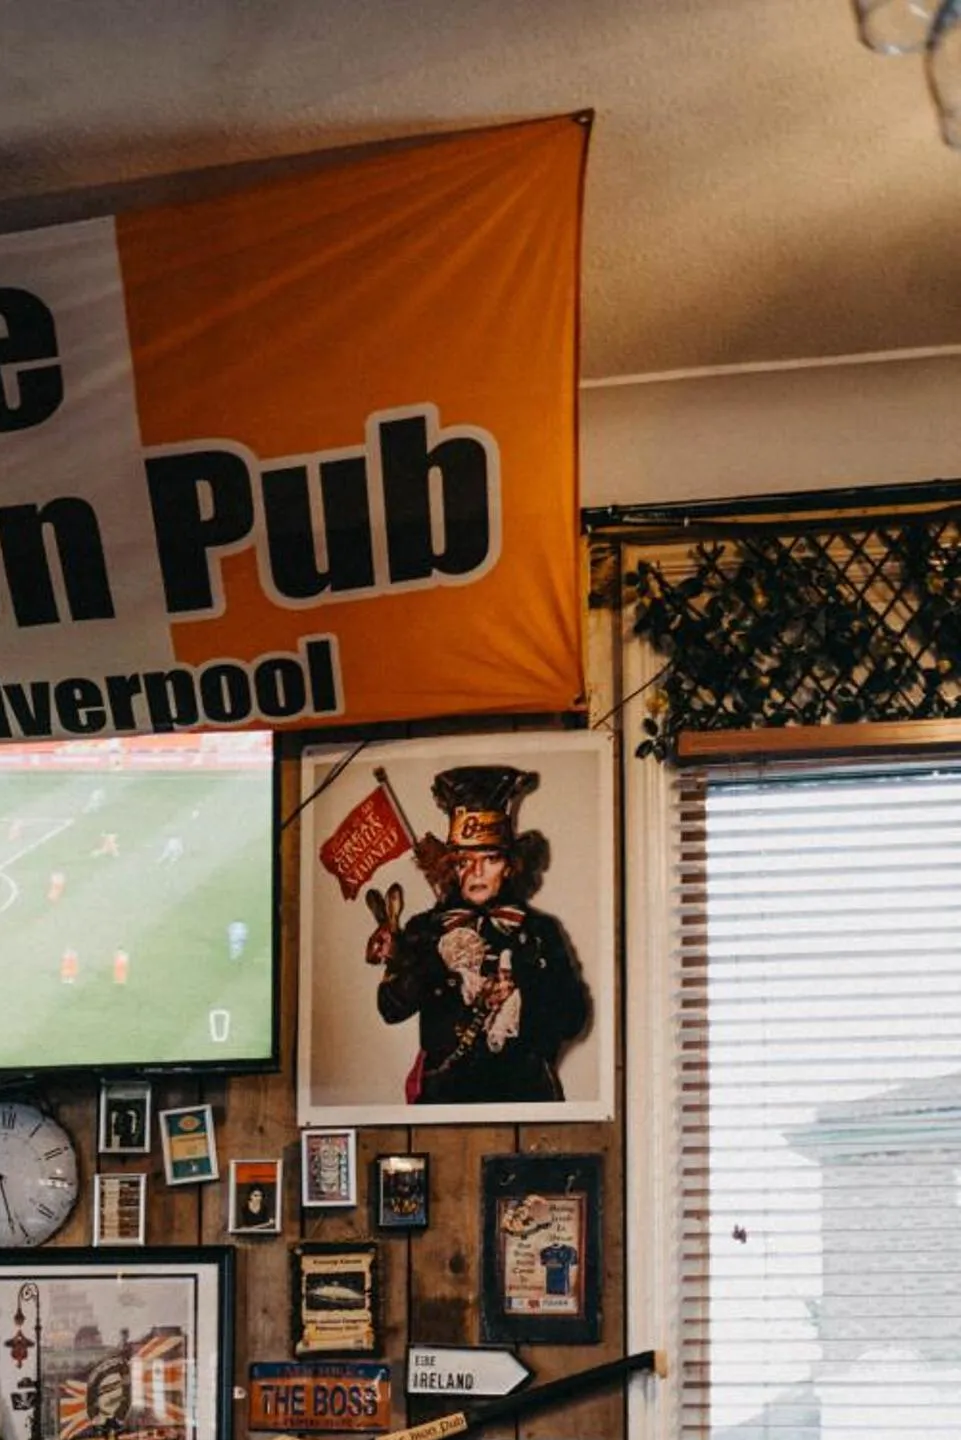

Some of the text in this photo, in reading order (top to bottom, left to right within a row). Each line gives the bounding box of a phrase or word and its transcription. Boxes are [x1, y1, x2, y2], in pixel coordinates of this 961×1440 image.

[142, 413, 492, 615] Pub
[412, 1371, 475, 1391] IRELAND
[261, 1383, 379, 1417] THE BOSS
